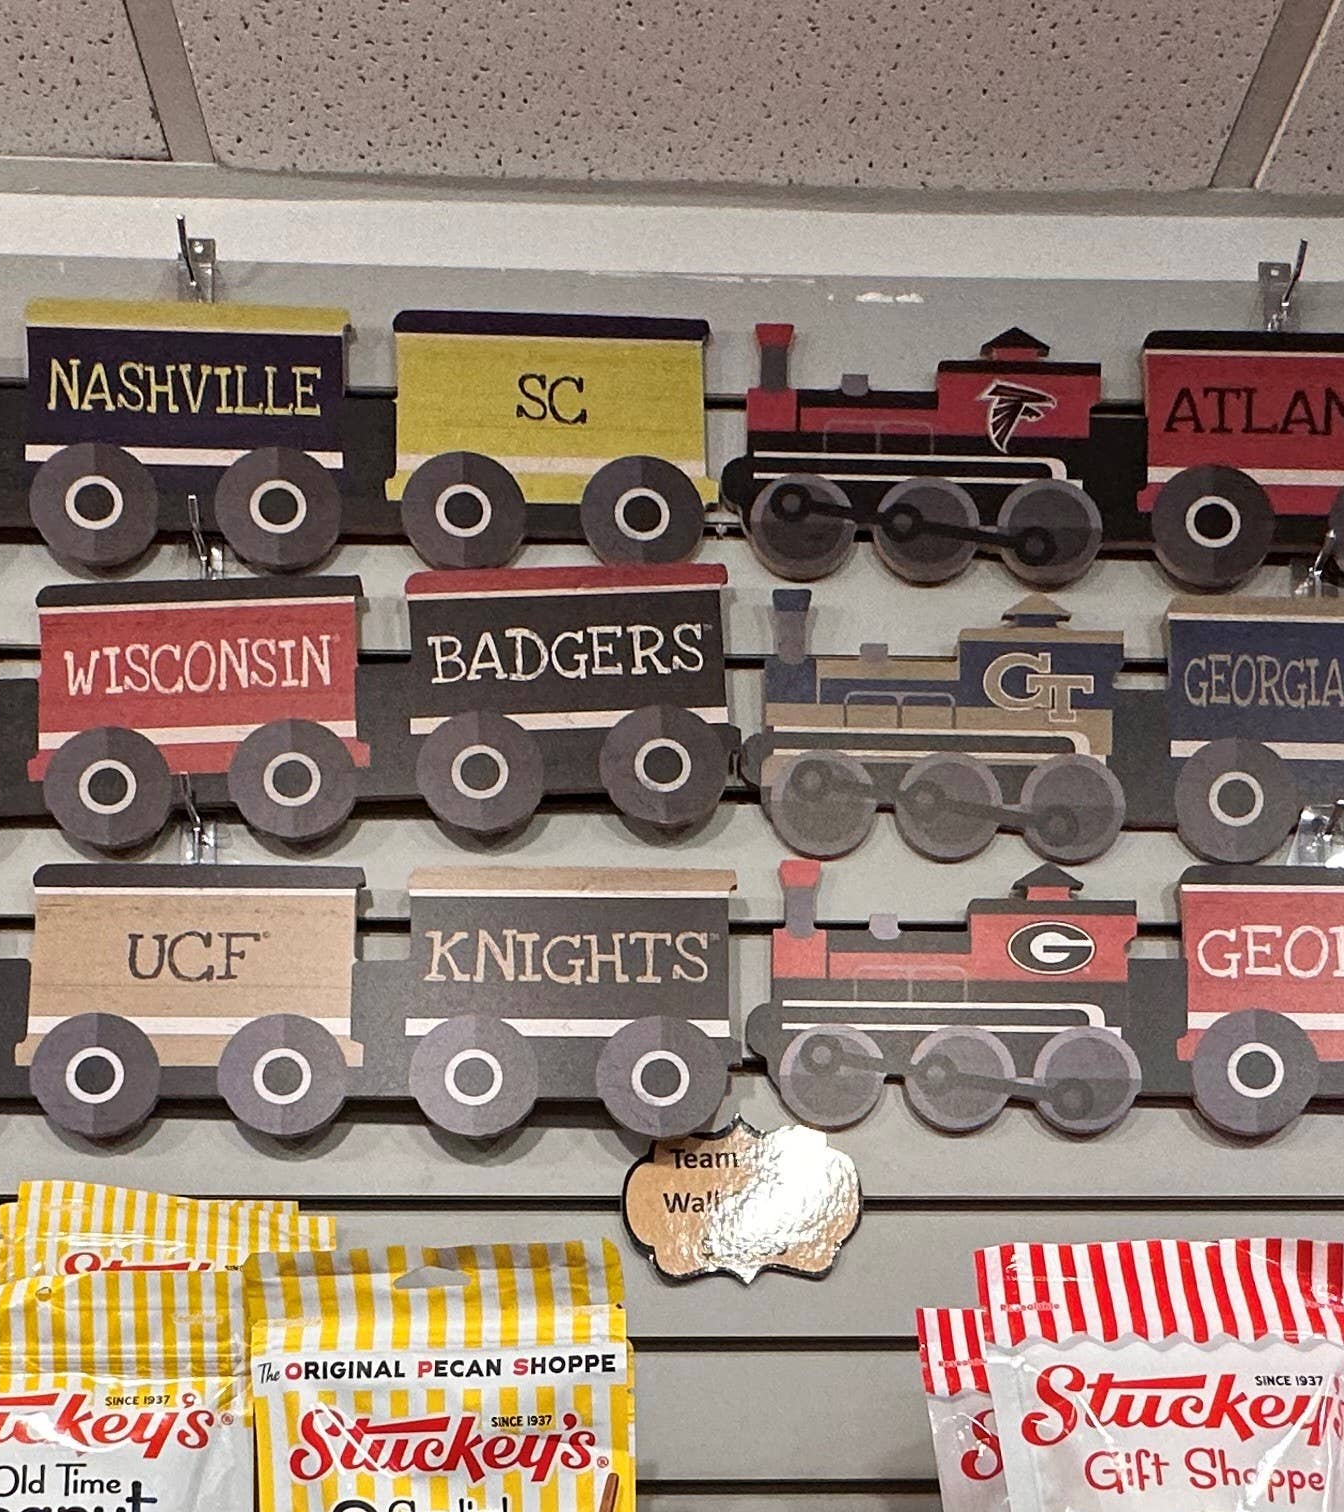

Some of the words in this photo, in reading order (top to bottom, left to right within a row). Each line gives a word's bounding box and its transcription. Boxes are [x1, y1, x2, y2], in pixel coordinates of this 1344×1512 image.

[48, 358, 322, 416] NASHVILLE
[515, 372, 587, 424] SC
[63, 635, 332, 695] WISCONSIN
[427, 622, 705, 685] BADGERS
[127, 932, 262, 981] UCF
[423, 929, 710, 986] KNIGHTS
[670, 1149, 739, 1169] Team
[258, 1361, 281, 1386] The
[284, 1358, 406, 1382] ORIGINAL
[417, 1356, 503, 1380] PECAN
[512, 1352, 617, 1377] SHOPPE
[105, 1396, 140, 1407] SINCE
[144, 1394, 170, 1406] 1937
[490, 1415, 523, 1428] SINCE
[525, 1414, 552, 1428] 1937
[289, 1411, 596, 1483] Stuckey's
[56, 1462, 122, 1496] Time
[1084, 1451, 1170, 1494] Gift
[1185, 1448, 1325, 1504] Shoppe
